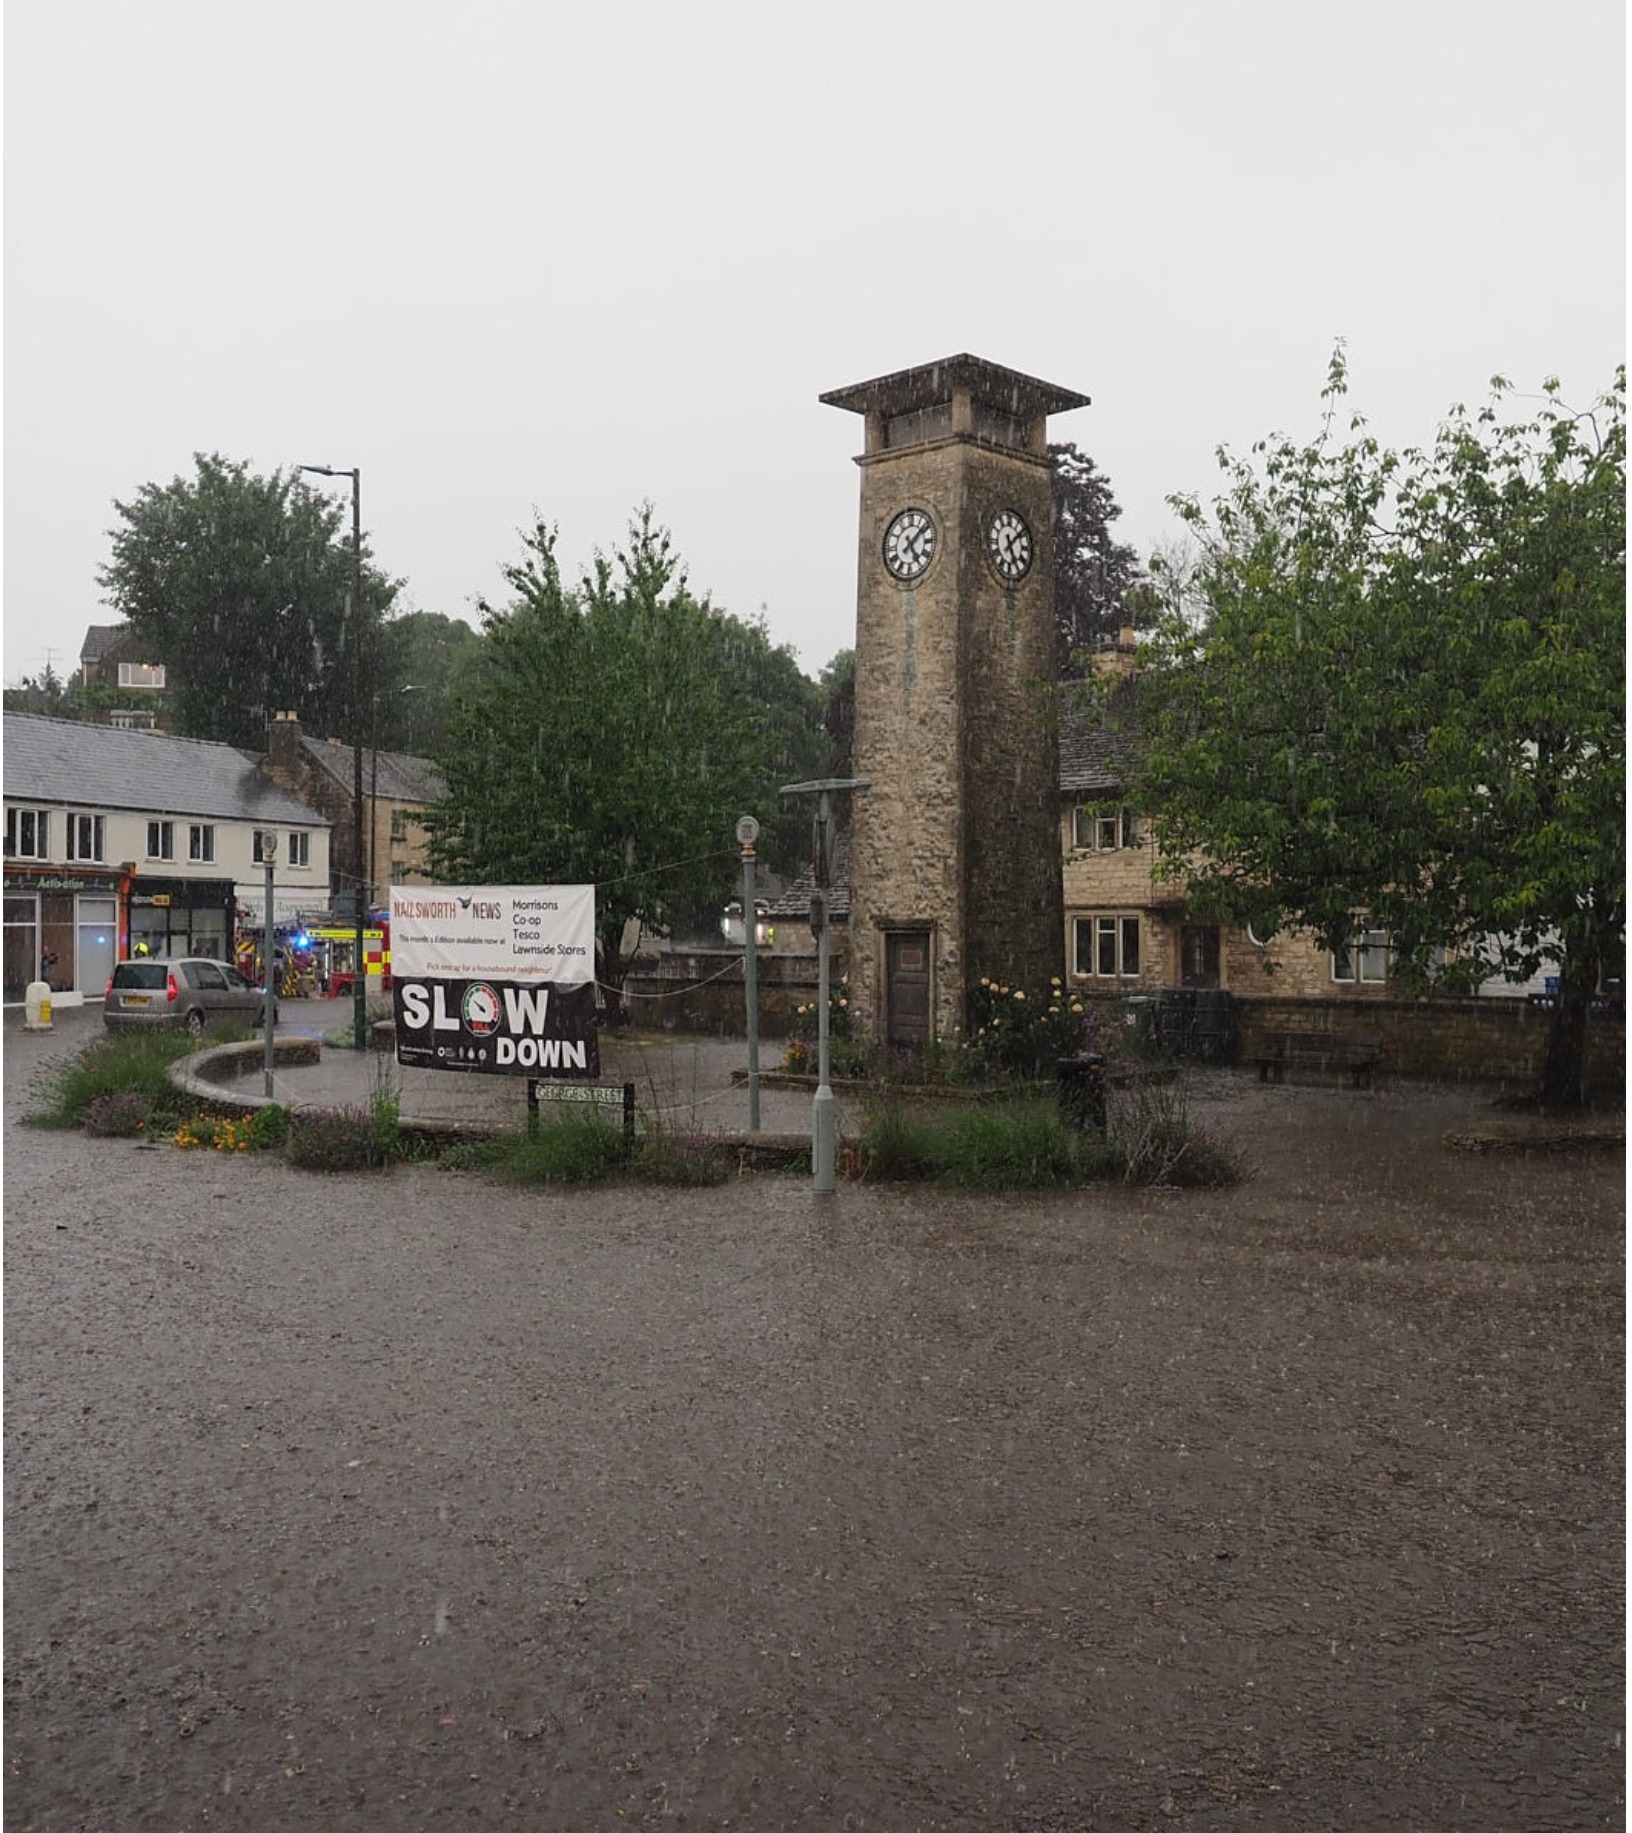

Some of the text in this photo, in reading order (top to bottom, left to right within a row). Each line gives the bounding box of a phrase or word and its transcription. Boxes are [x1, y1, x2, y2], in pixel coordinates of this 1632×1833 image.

[394, 901, 502, 920] NAILSWORTH NEWS
[512, 899, 559, 911] Morrisons
[512, 914, 542, 927] Co-op
[512, 928, 540, 941] Tesco
[512, 943, 587, 956] Lawnside Stores
[496, 1037, 587, 1069] DOWN
